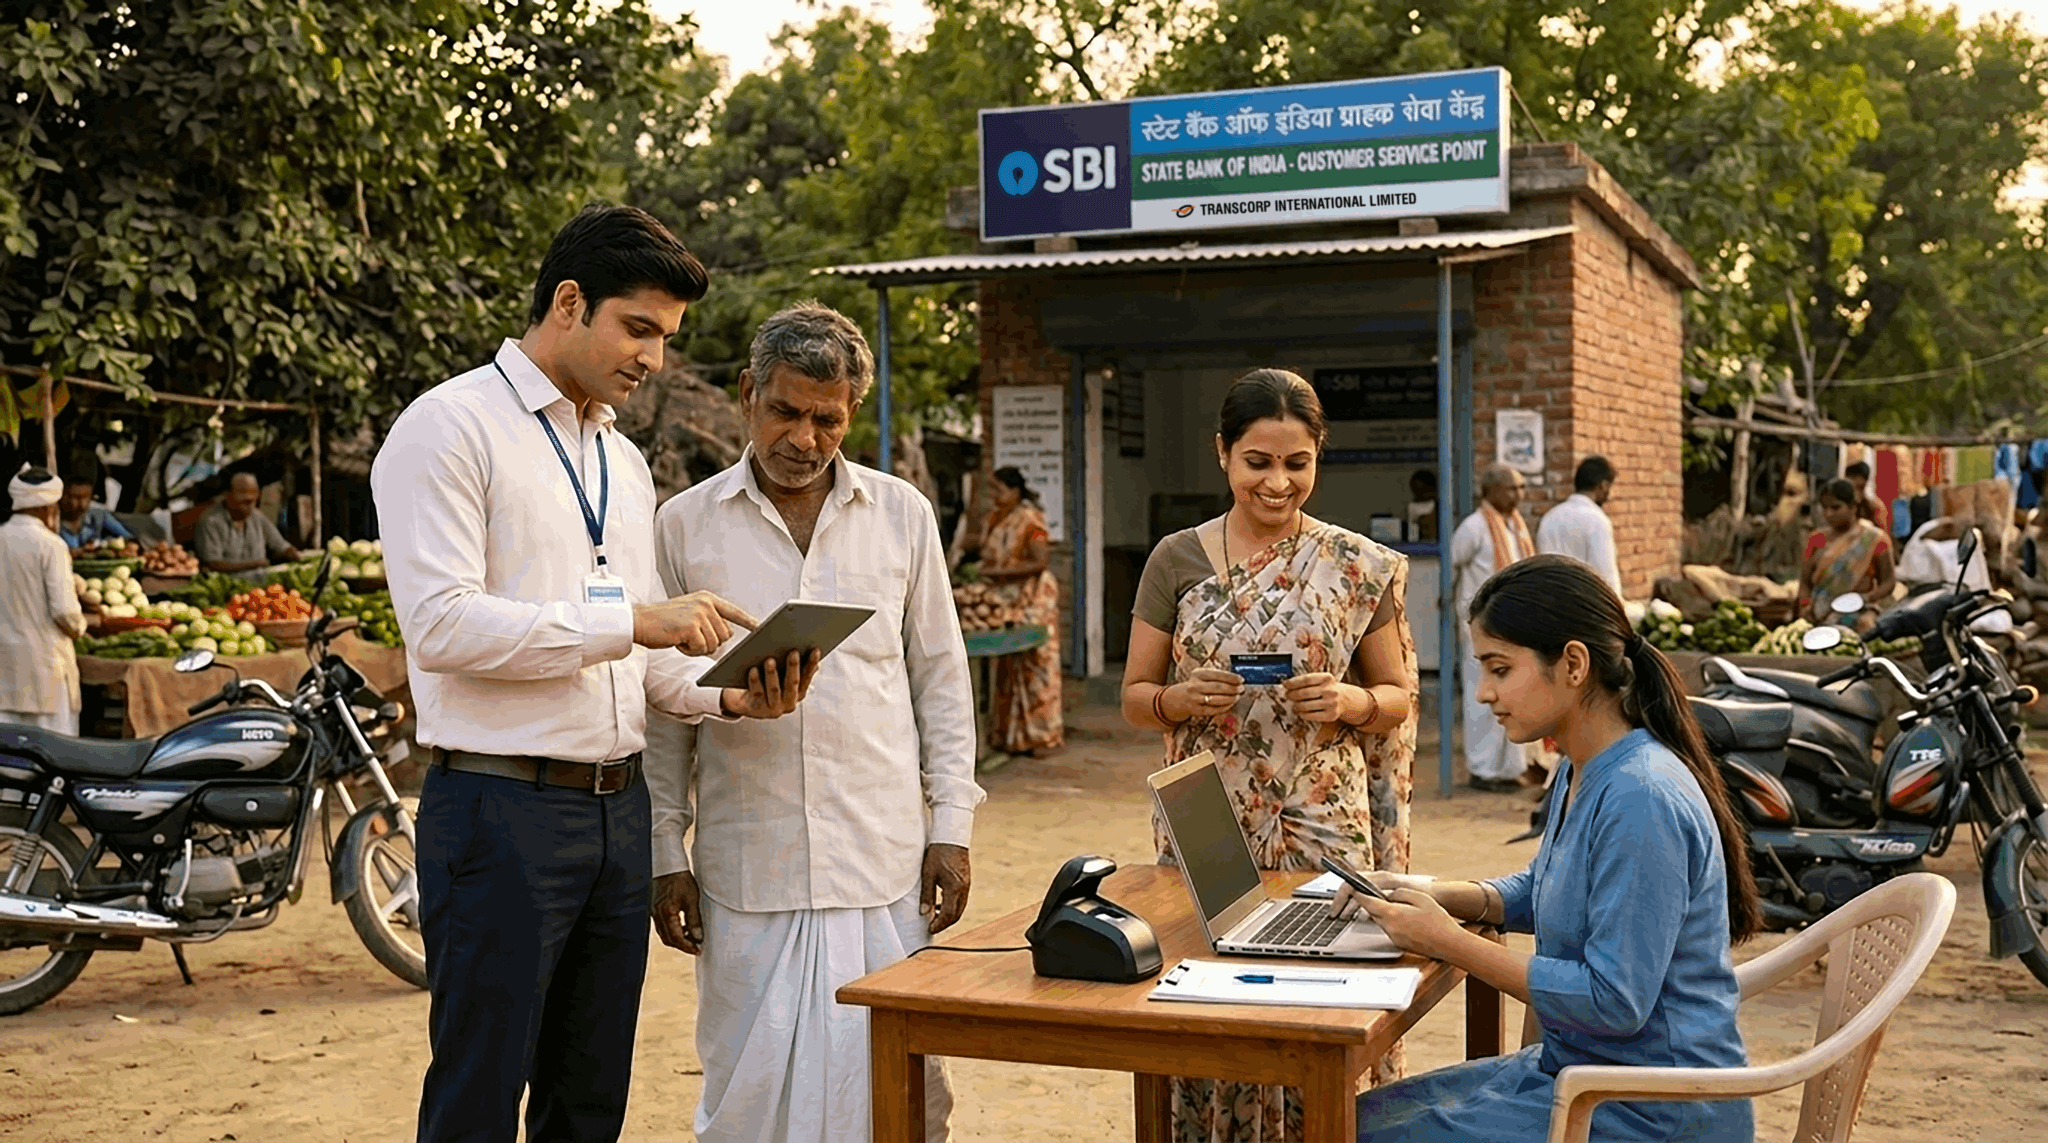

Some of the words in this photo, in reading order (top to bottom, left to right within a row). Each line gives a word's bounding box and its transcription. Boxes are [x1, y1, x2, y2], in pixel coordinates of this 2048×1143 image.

[1141, 113, 1181, 141] स्टेट
[1225, 106, 1269, 135] ऑफ
[1274, 103, 1333, 135] इंडिया
[1338, 103, 1395, 128] ग्राहक
[1043, 145, 1116, 193] SBI
[1141, 160, 1183, 183] STATE
[1186, 157, 1224, 180] BANK
[1227, 156, 1245, 177] OF
[1248, 153, 1287, 175] INDIA
[1297, 147, 1375, 172] CUSTOMER
[1378, 143, 1440, 167] SERVICE
[1442, 139, 1487, 163] POINT
[1200, 200, 1271, 216] TRANSCORP
[1275, 195, 1366, 212] INTERNATIONAL
[1369, 192, 1417, 207] LIMITED
